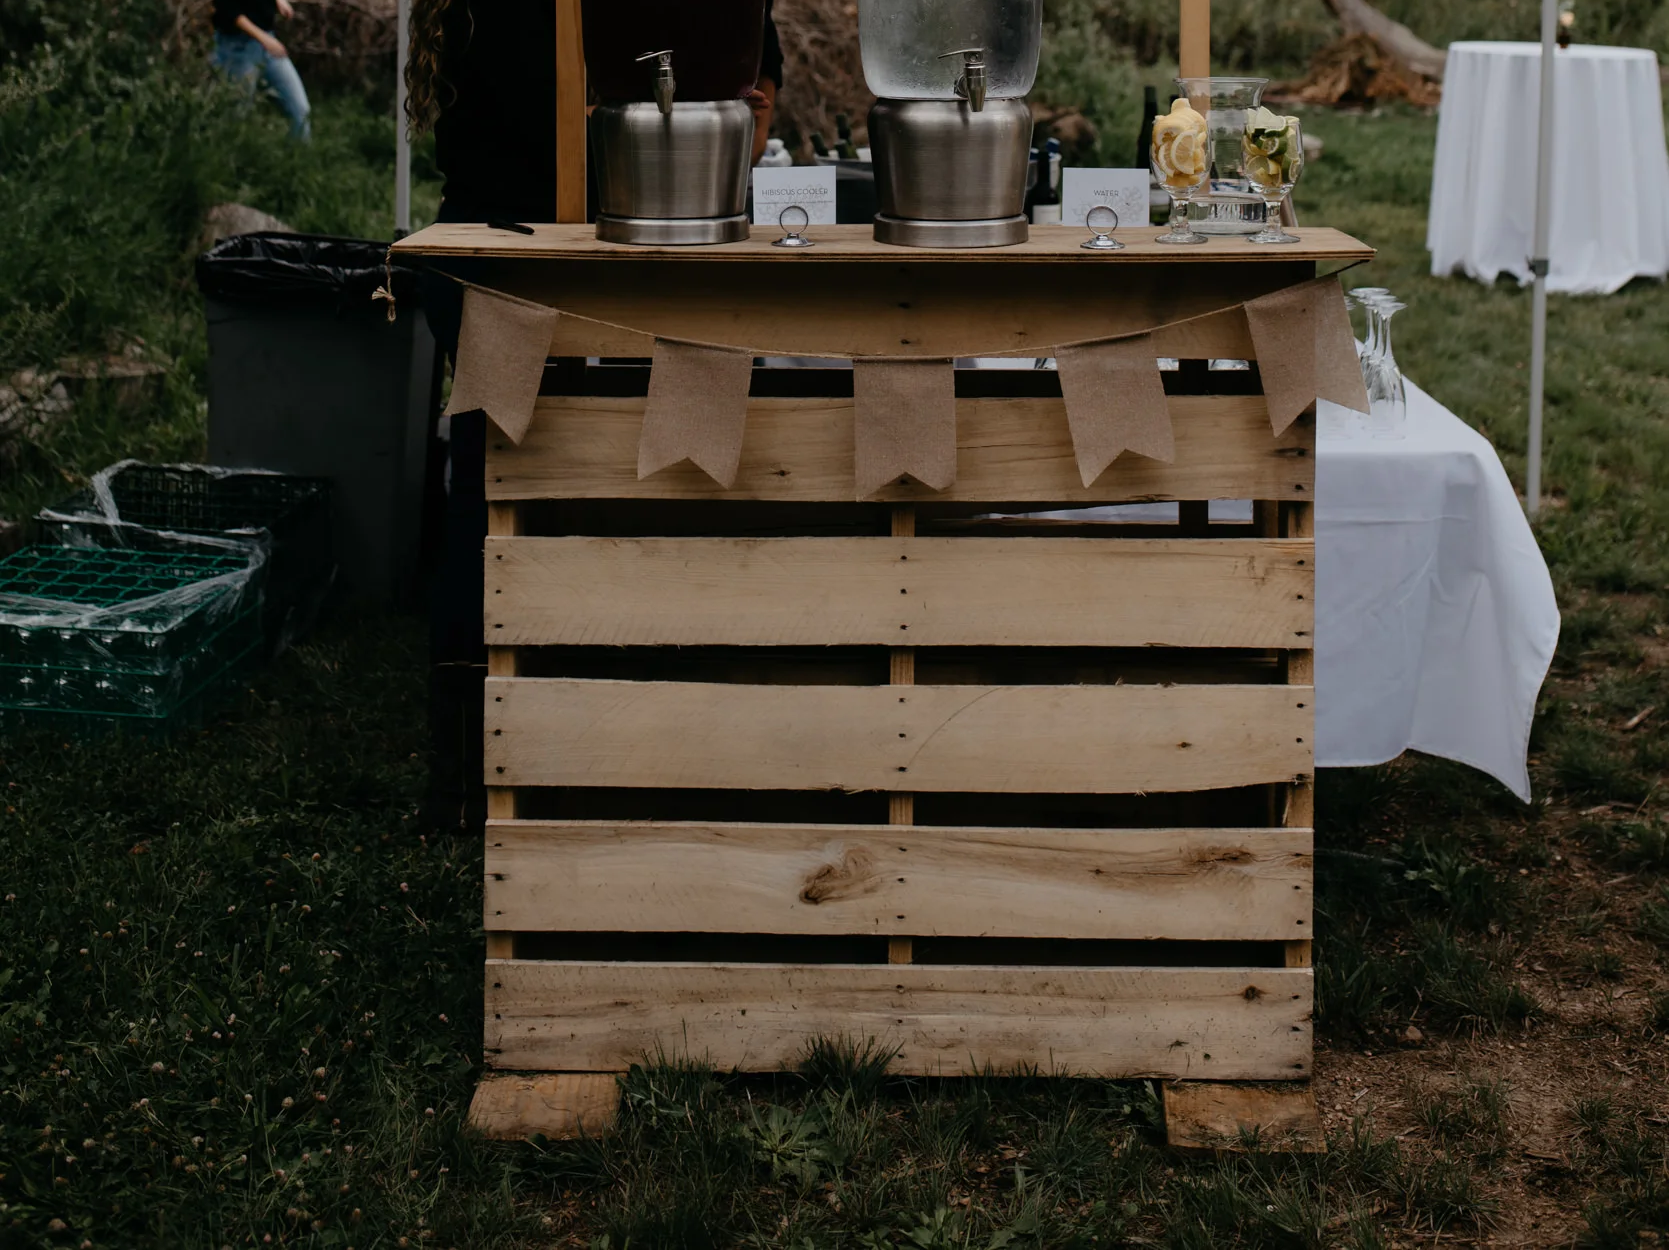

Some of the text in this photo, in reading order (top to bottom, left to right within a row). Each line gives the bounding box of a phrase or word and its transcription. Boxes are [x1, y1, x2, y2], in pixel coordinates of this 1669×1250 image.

[761, 187, 829, 196] HIBISCUS COOLER
[1093, 189, 1120, 197] WATER
